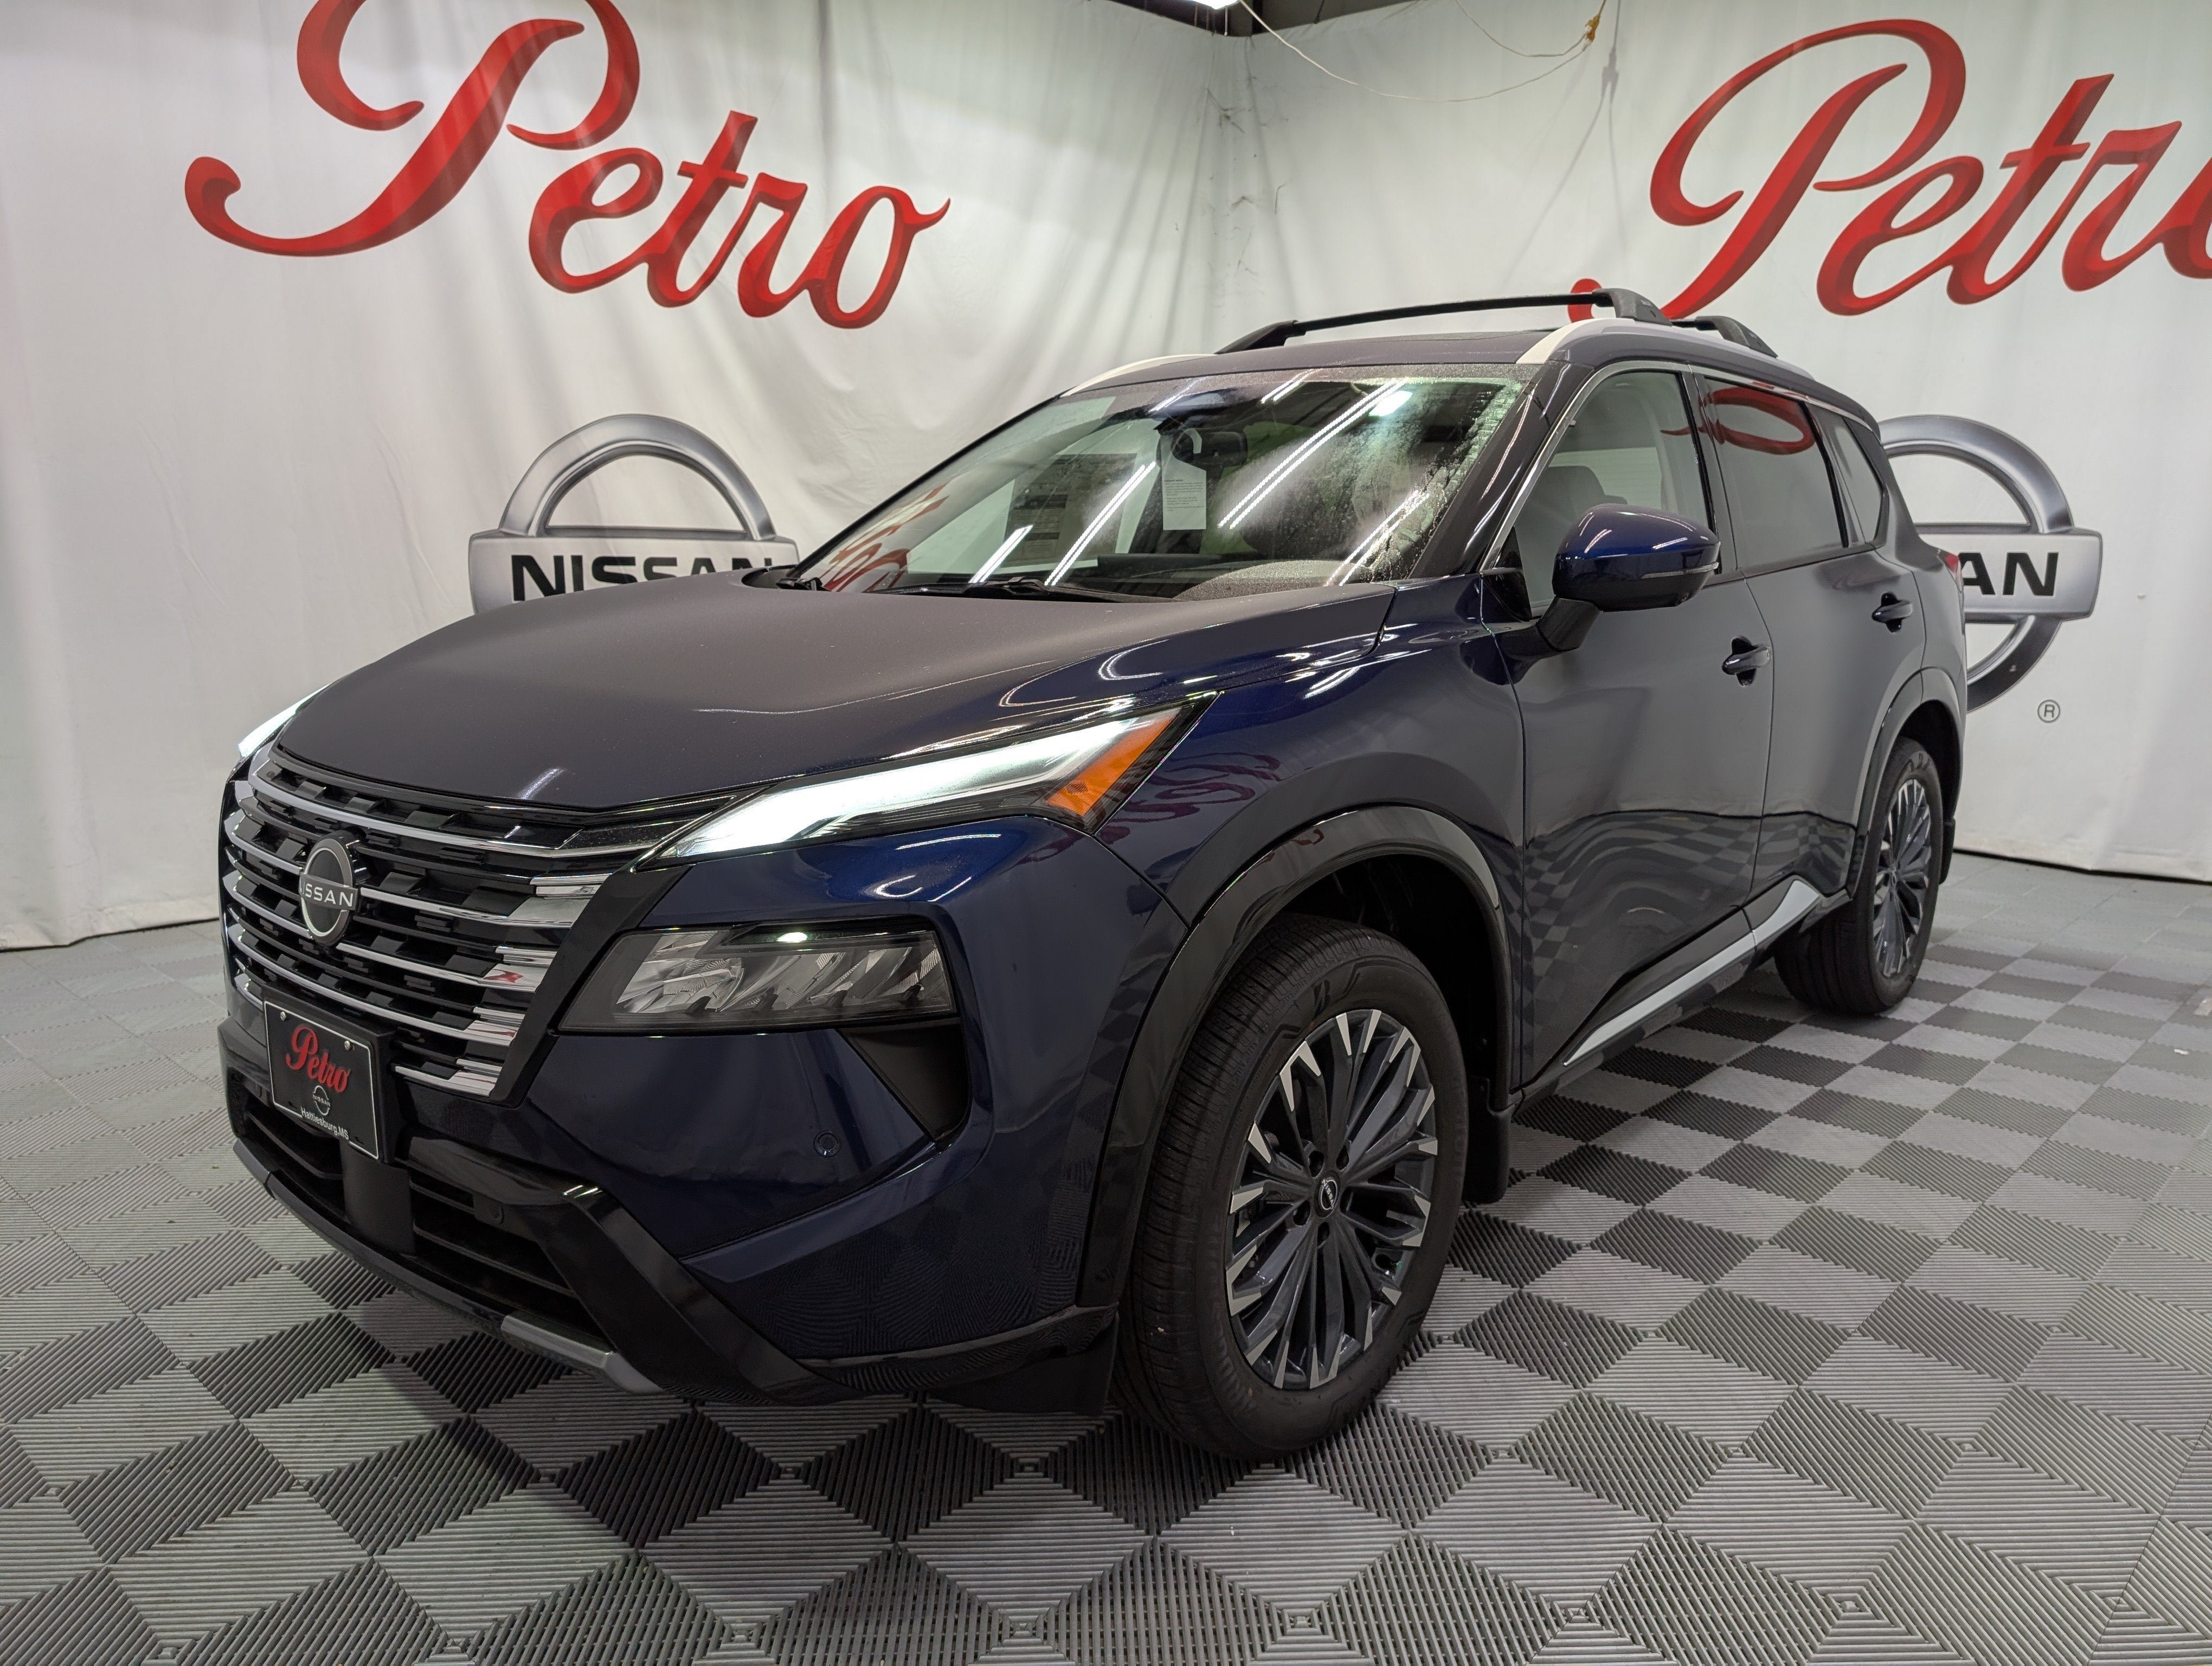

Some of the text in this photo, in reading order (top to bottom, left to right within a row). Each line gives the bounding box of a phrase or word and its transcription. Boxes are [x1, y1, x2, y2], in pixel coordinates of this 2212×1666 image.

[184, 0, 951, 330] Petro
[285, 1024, 350, 1093] Petro
[312, 1094, 331, 1107] NISSAN
